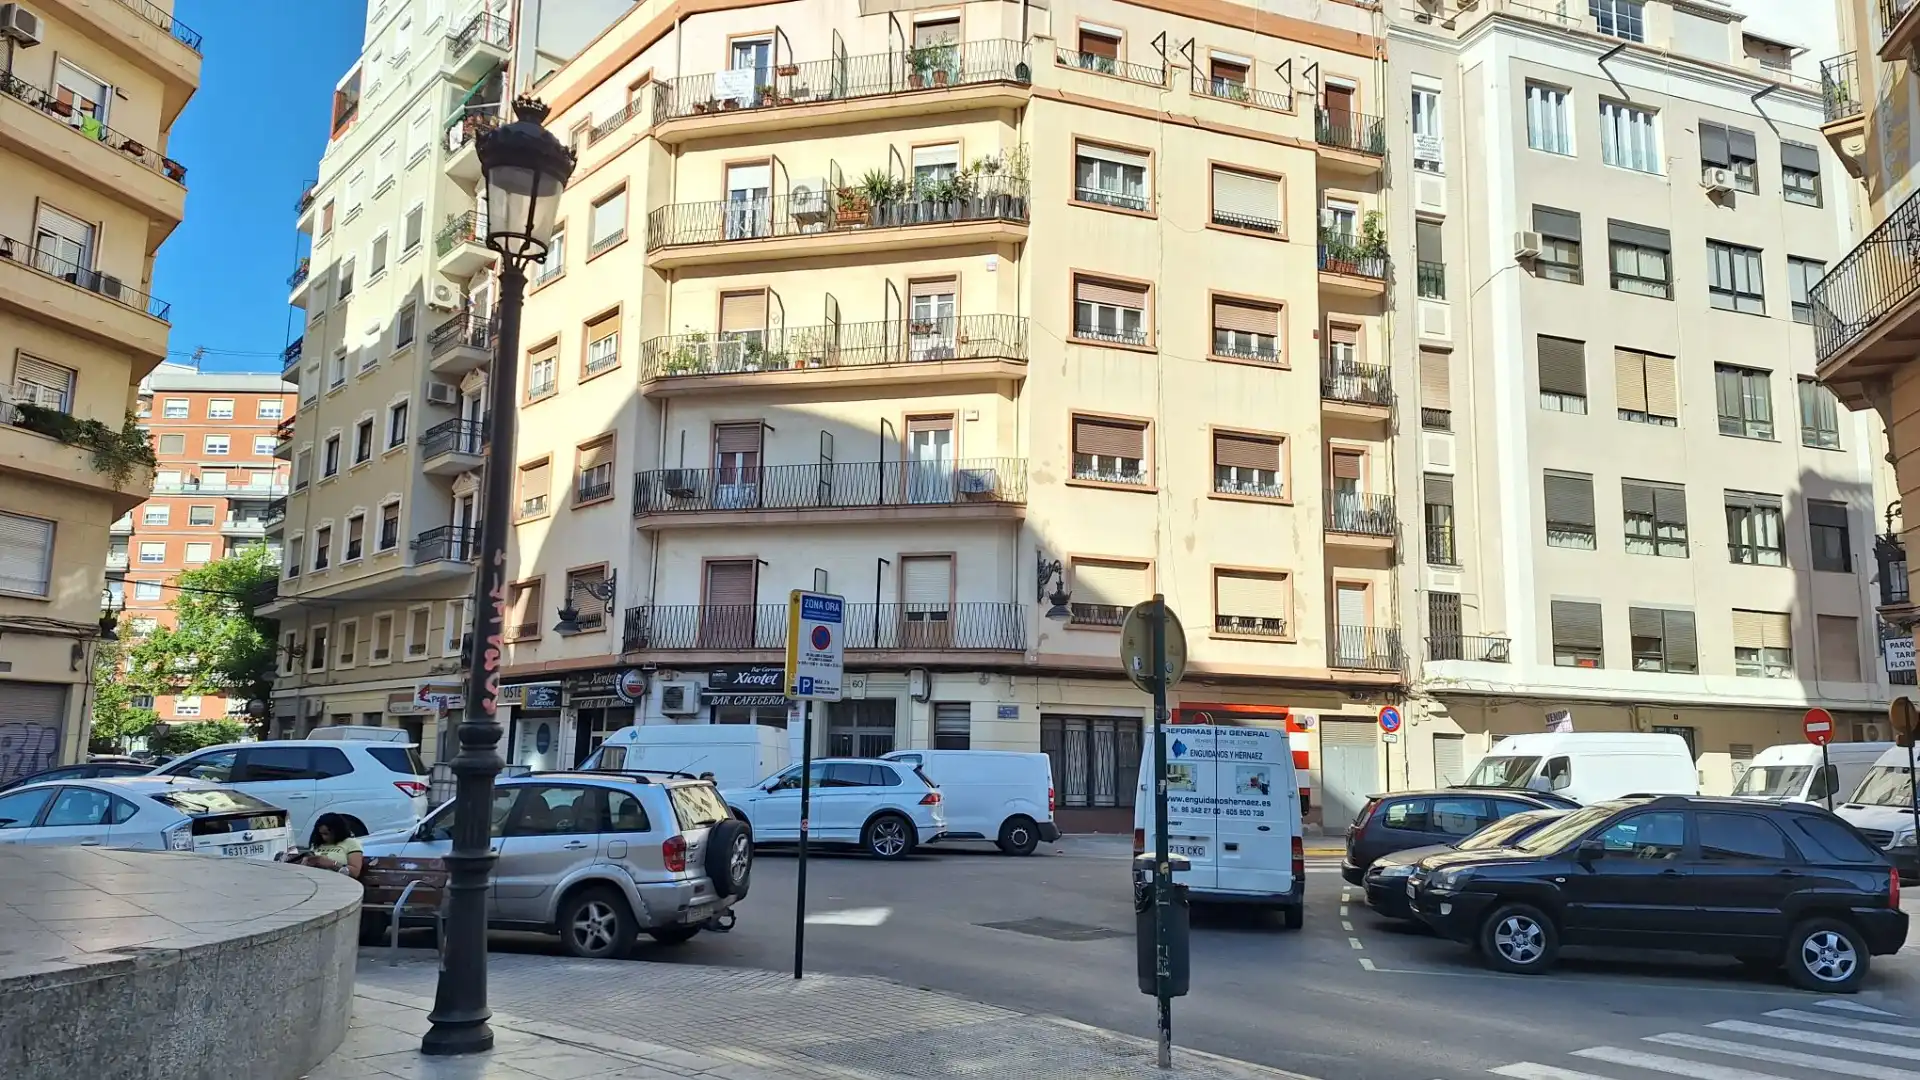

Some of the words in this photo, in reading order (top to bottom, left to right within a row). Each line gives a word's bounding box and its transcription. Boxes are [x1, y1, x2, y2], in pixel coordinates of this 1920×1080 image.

[804, 598, 824, 610] ZONA
[825, 601, 840, 612] ORA
[732, 672, 779, 685] Xicotet
[802, 679, 811, 692] P
[852, 680, 864, 688] 60
[711, 695, 731, 705] BAR
[1166, 727, 1212, 736] REFORMAS
[1231, 729, 1270, 738] GENERAL
[1234, 751, 1264, 760] HERNAEZ
[228, 847, 249, 856] 6313
[1187, 846, 1205, 856] CKC
